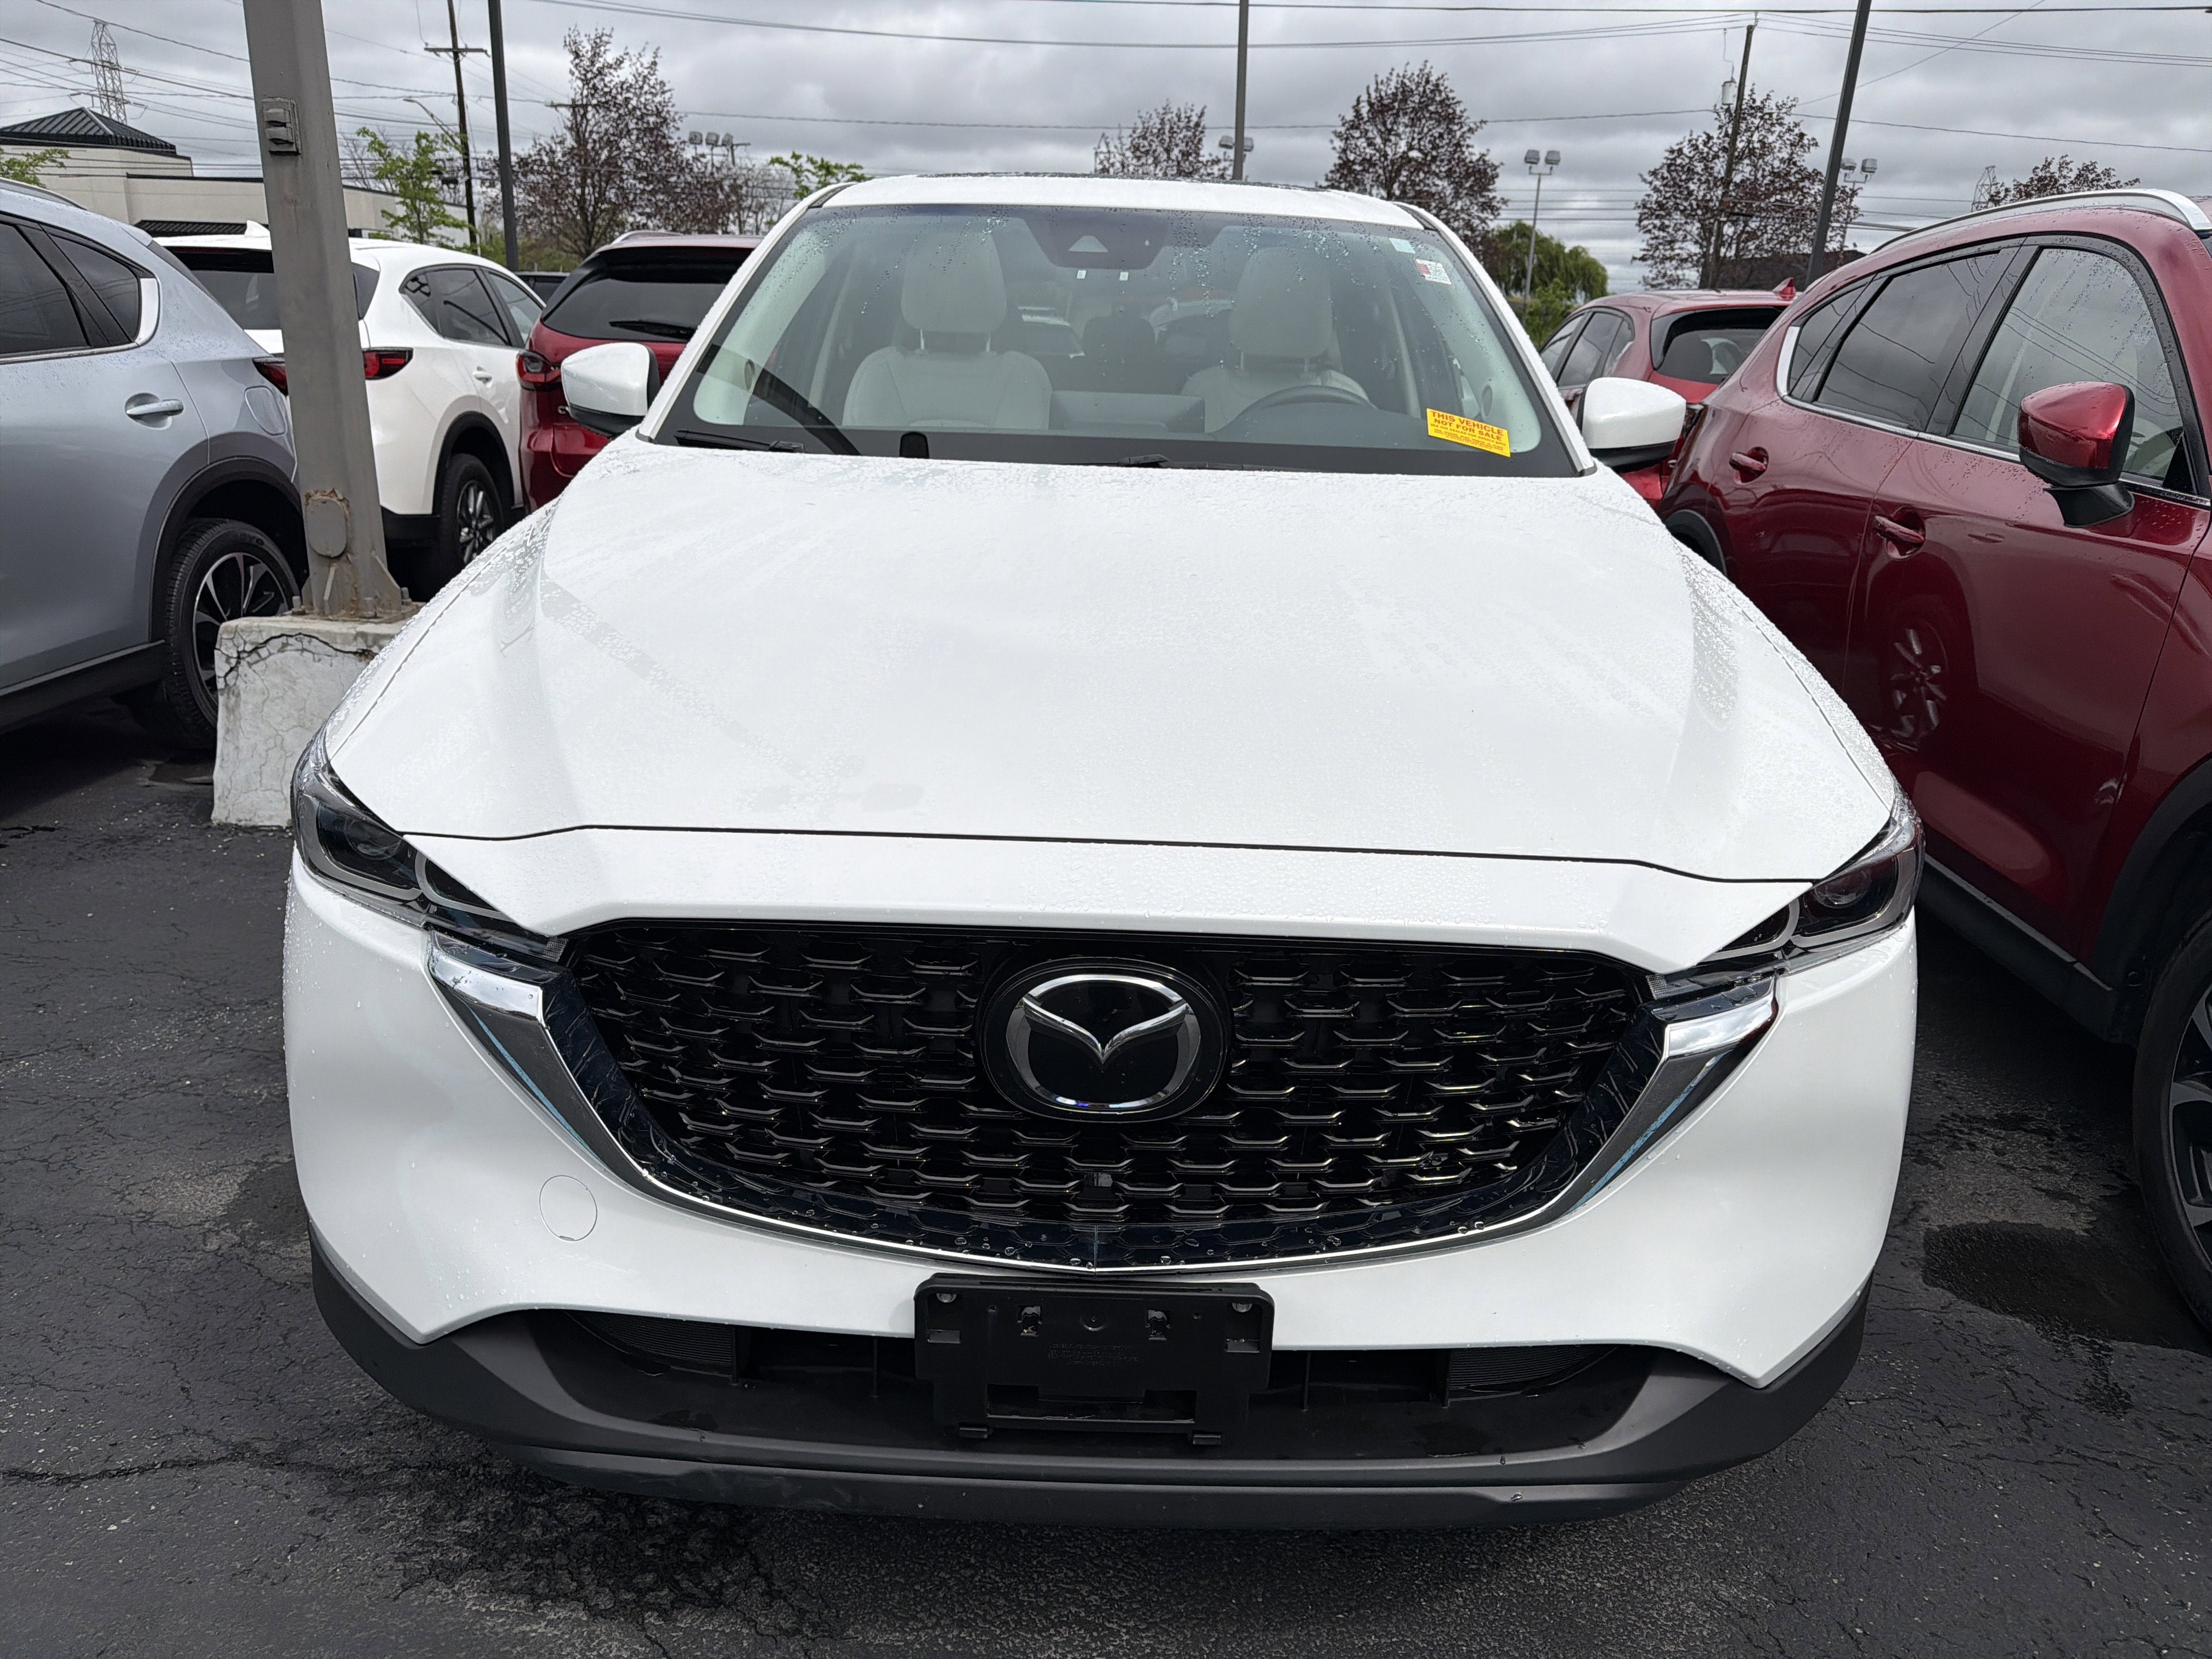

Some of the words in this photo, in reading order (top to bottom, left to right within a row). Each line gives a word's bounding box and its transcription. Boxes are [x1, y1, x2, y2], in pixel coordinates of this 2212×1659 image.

[1431, 411, 1455, 422] THIS
[1458, 418, 1503, 436] VEHICLE
[1434, 419, 1453, 427] NOT
[1456, 424, 1475, 433] FOR
[1478, 430, 1502, 441] SALE
